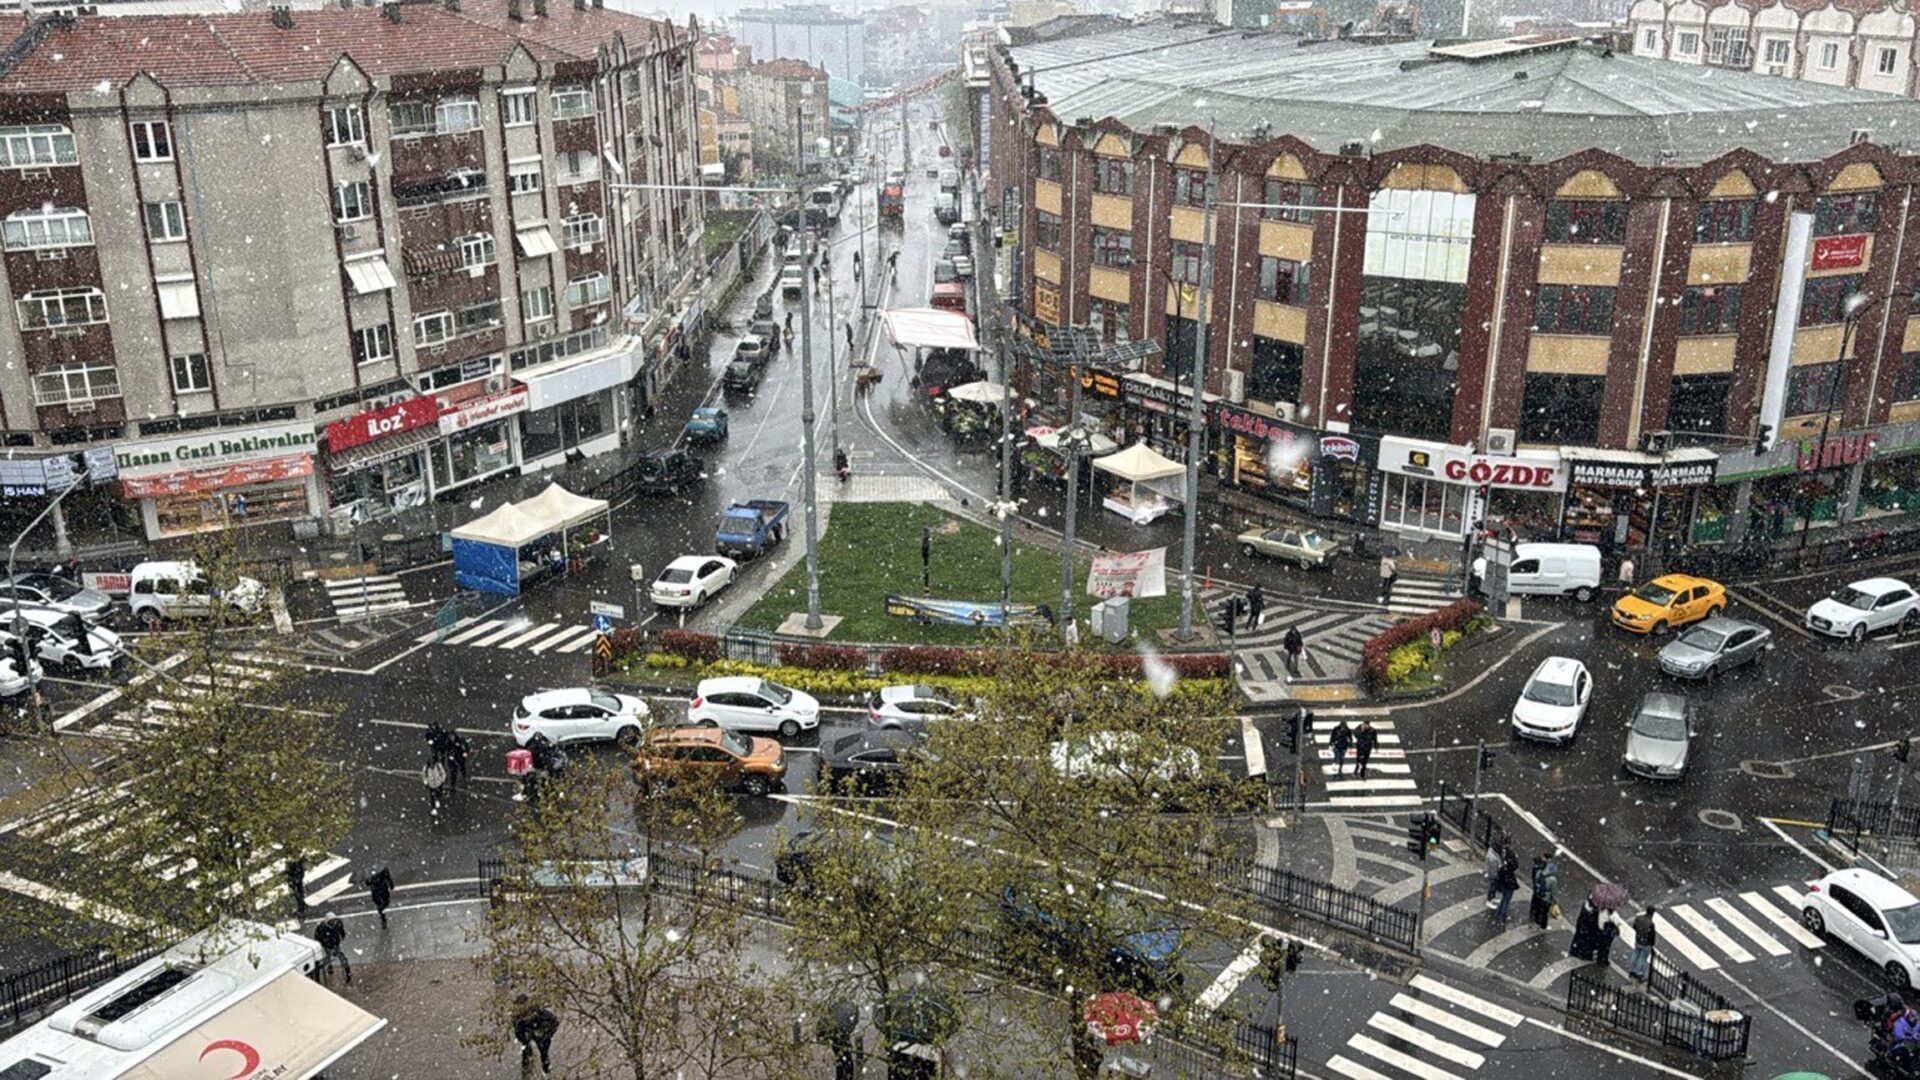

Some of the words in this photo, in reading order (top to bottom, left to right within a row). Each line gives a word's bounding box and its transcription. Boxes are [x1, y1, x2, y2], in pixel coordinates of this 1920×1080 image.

[117, 451, 172, 469] Hasan
[176, 442, 215, 460] Gazi
[1445, 458, 1553, 487] GÖZDE
[1575, 465, 1644, 480] MARMARA
